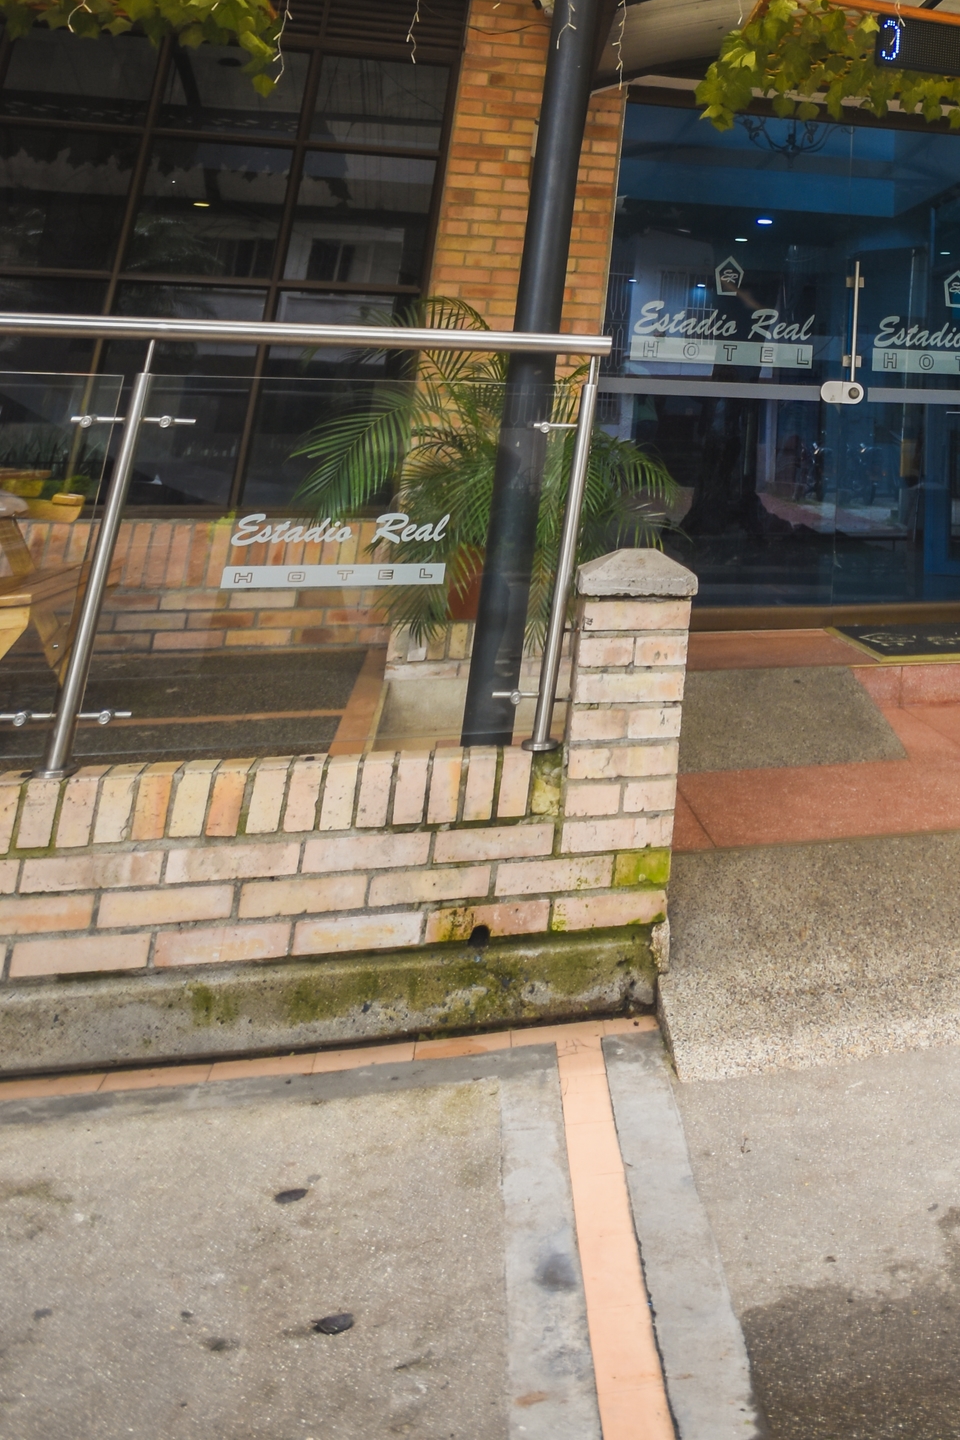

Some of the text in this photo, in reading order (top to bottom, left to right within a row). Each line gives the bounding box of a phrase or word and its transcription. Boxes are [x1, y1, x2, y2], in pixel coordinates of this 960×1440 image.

[633, 300, 815, 341] Estadio Real
[642, 340, 810, 366] HOTEL
[230, 512, 450, 547] Estadio Real
[233, 567, 433, 584] HOTEL
